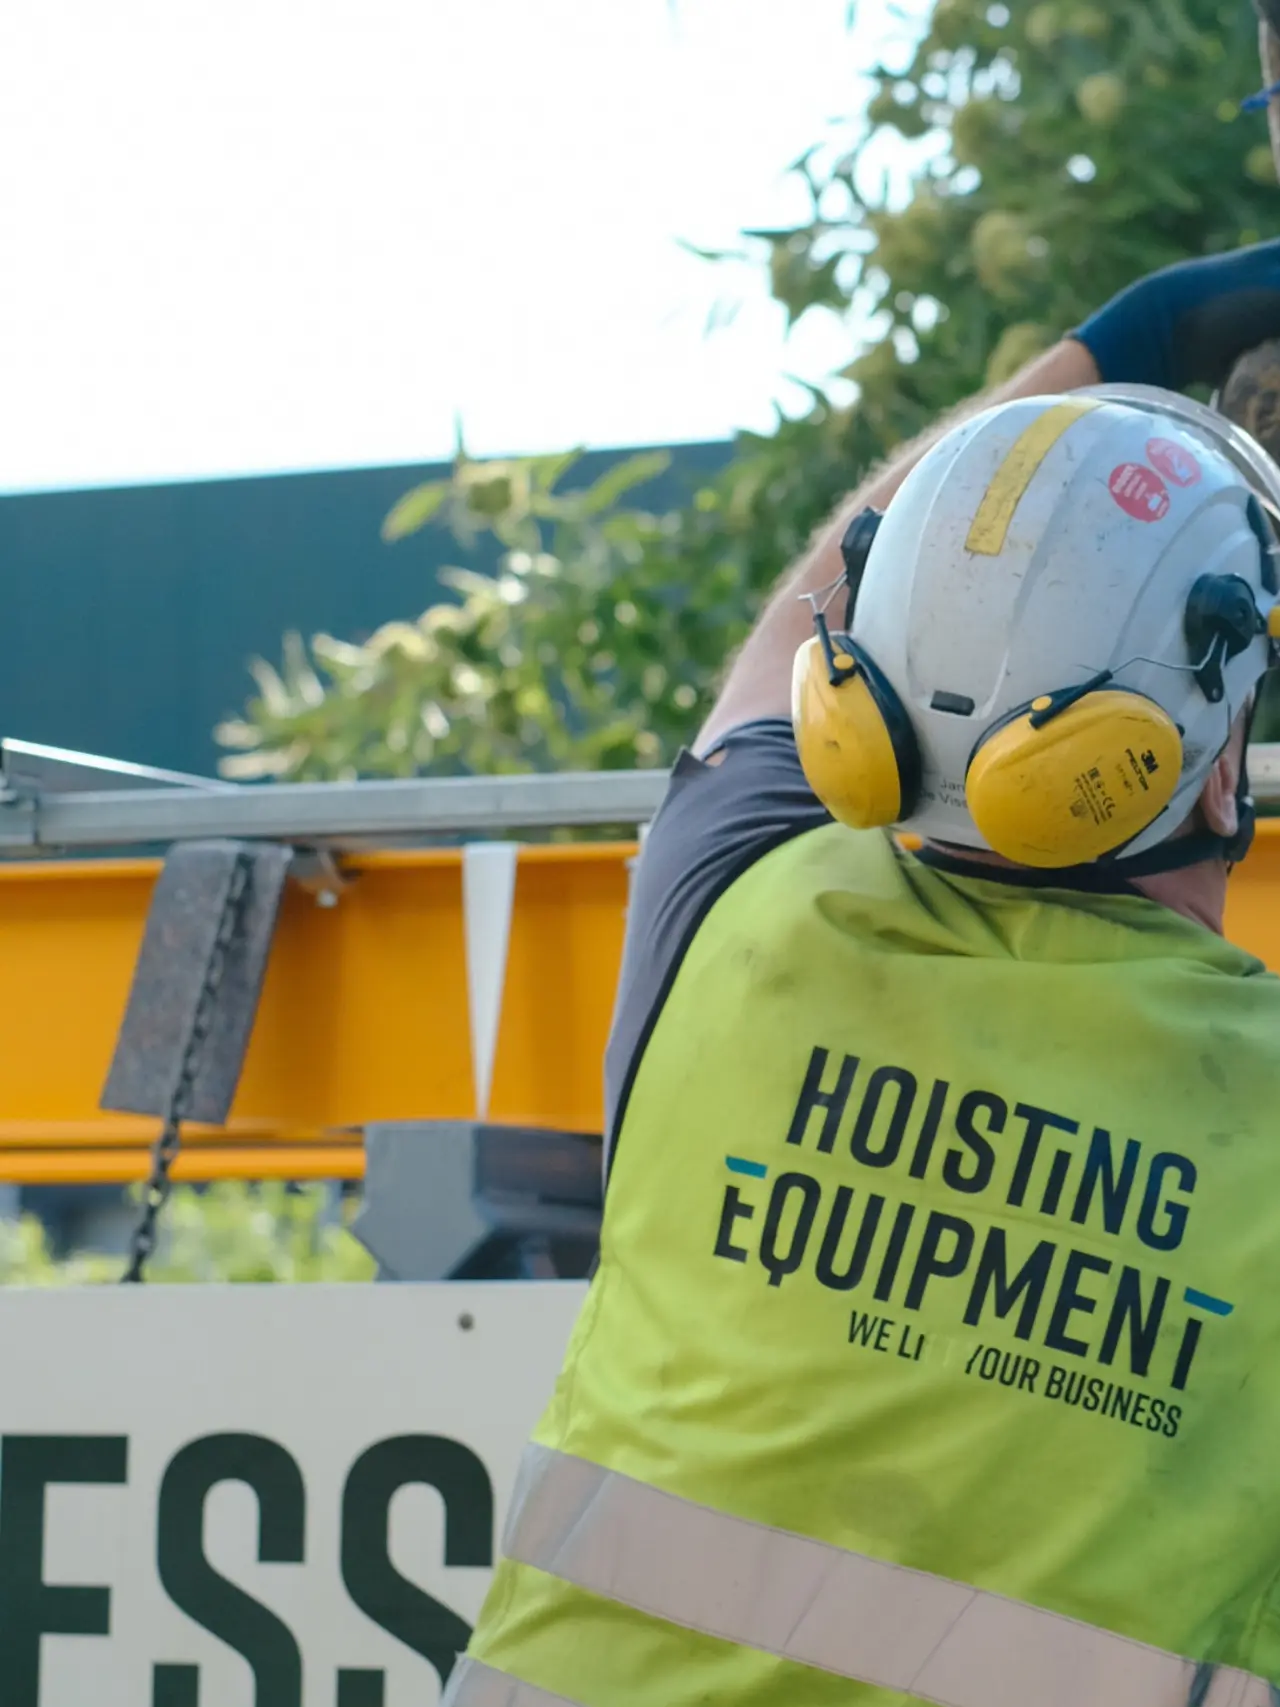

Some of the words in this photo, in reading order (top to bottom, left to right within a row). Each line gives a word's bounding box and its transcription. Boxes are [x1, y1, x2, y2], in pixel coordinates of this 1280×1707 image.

[1141, 749, 1159, 774] 3M
[785, 1045, 1198, 1251] HOISTING
[713, 1155, 1234, 1391] EQUIPMENT
[848, 1310, 895, 1352] WE
[1044, 1365, 1184, 1439] BUSINESS
